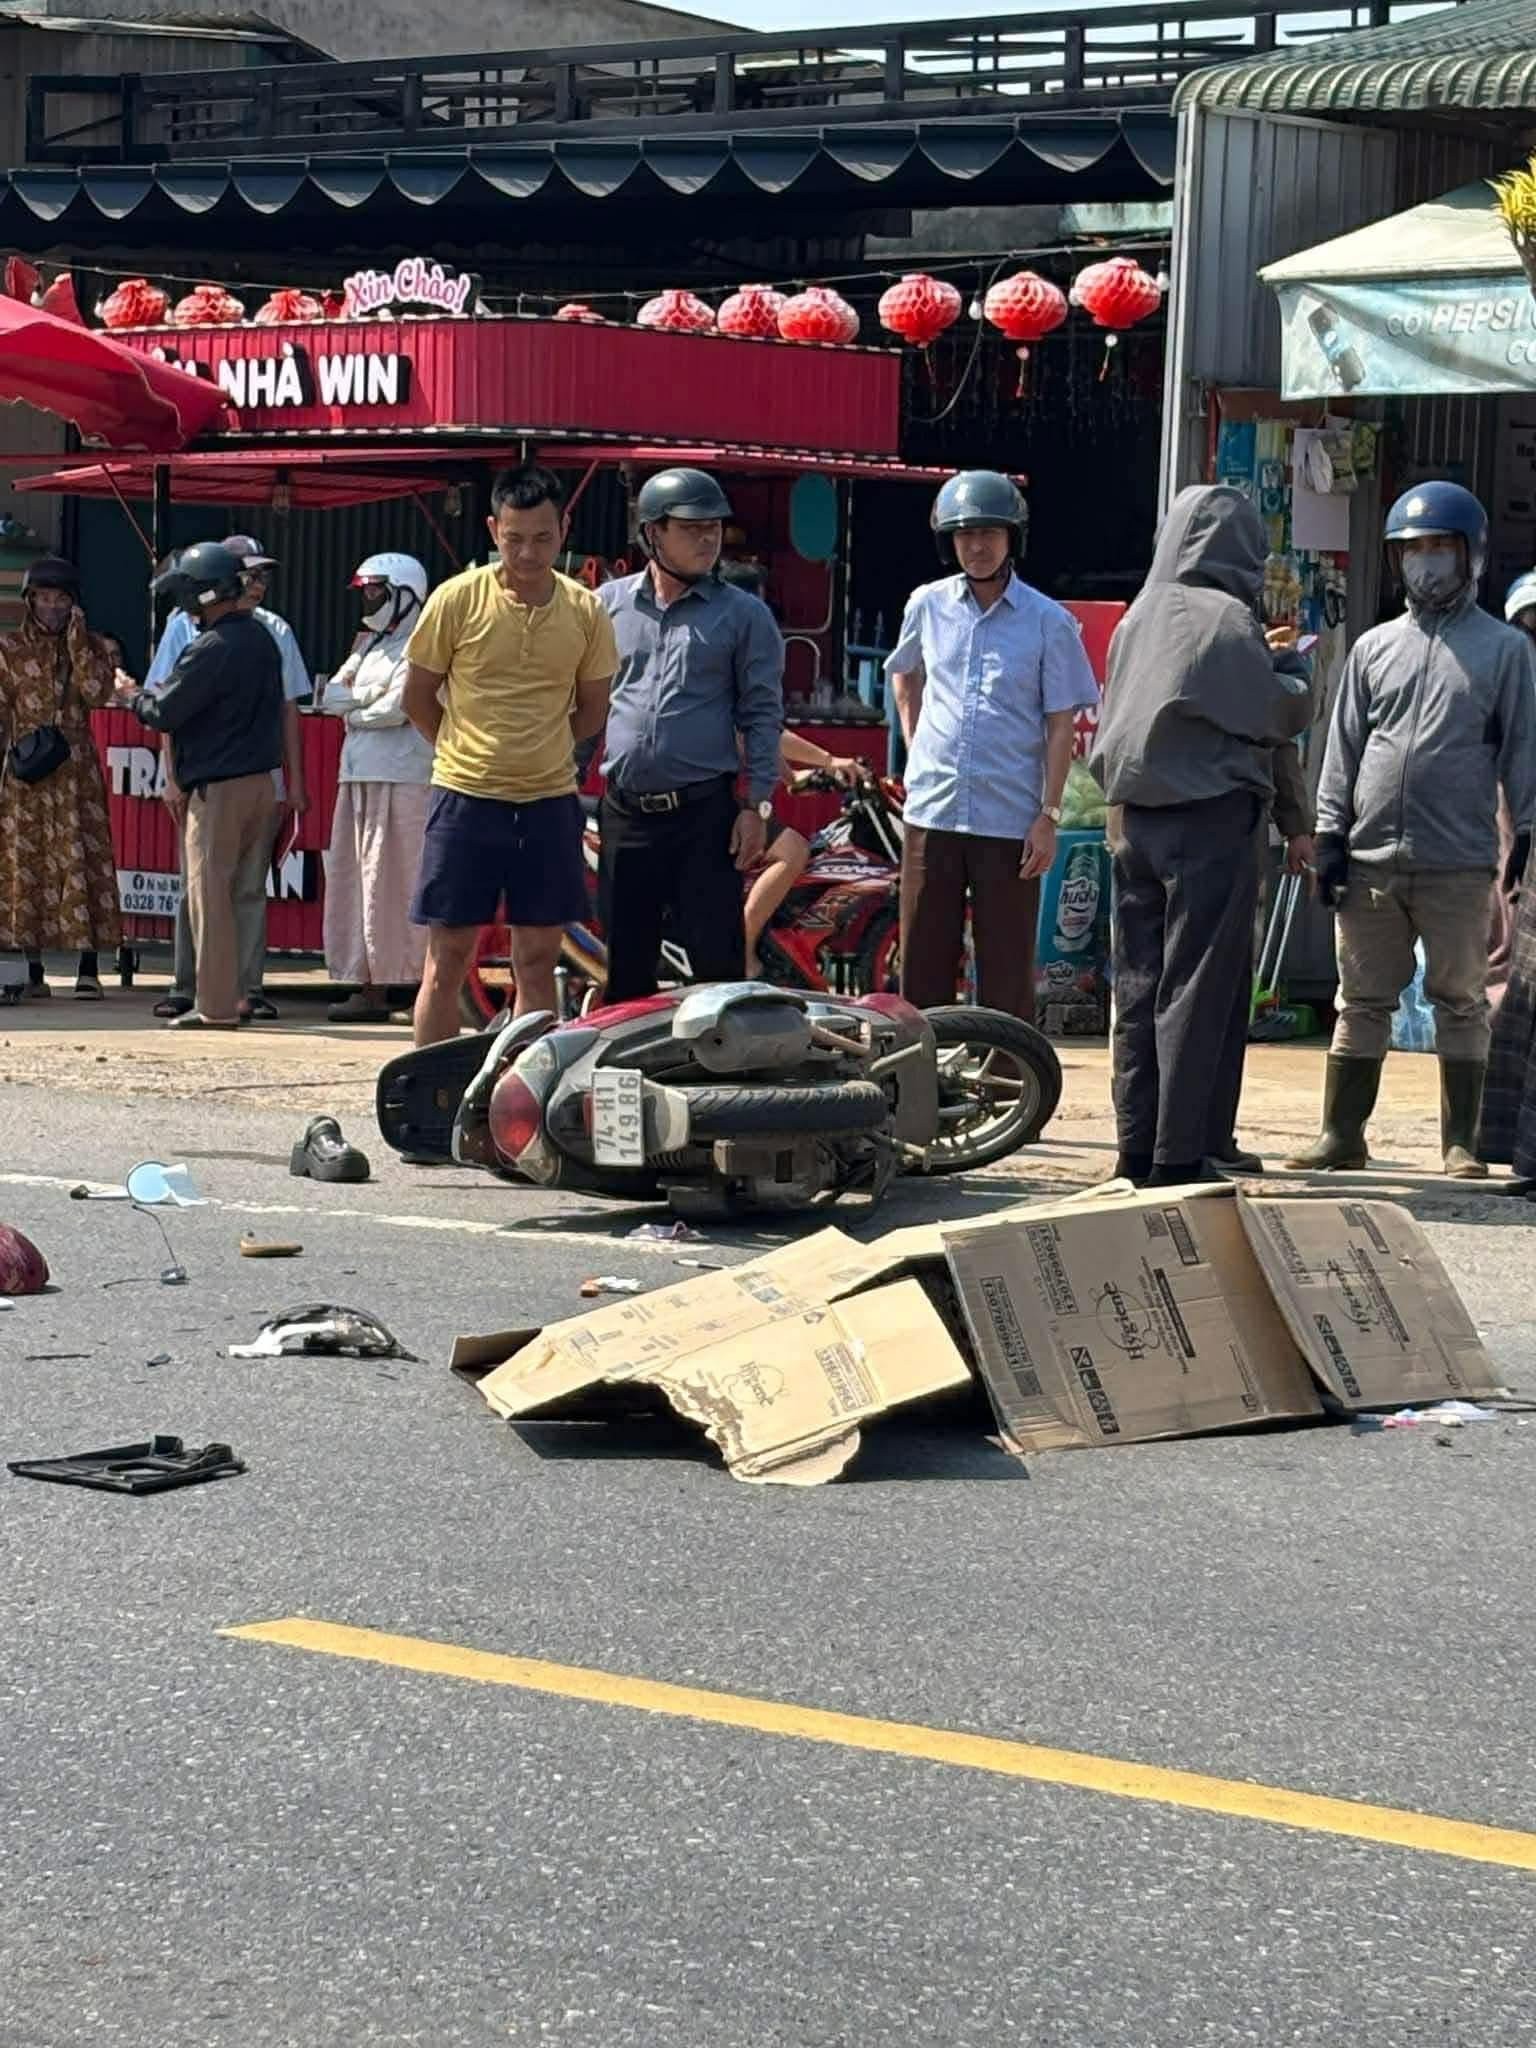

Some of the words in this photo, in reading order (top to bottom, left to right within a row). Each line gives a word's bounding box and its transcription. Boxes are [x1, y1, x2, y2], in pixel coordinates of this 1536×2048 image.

[344, 270, 393, 315] Xin
[395, 257, 470, 314] Chào!
[1429, 298, 1525, 334] PEPSI
[218, 342, 304, 408] NHÀ
[318, 353, 399, 406] WIN
[124, 893, 154, 911] 0328
[596, 1086, 616, 1152] 74-H1
[618, 1075, 640, 1159] 149.86
[1103, 1280, 1145, 1361] Hygiene
